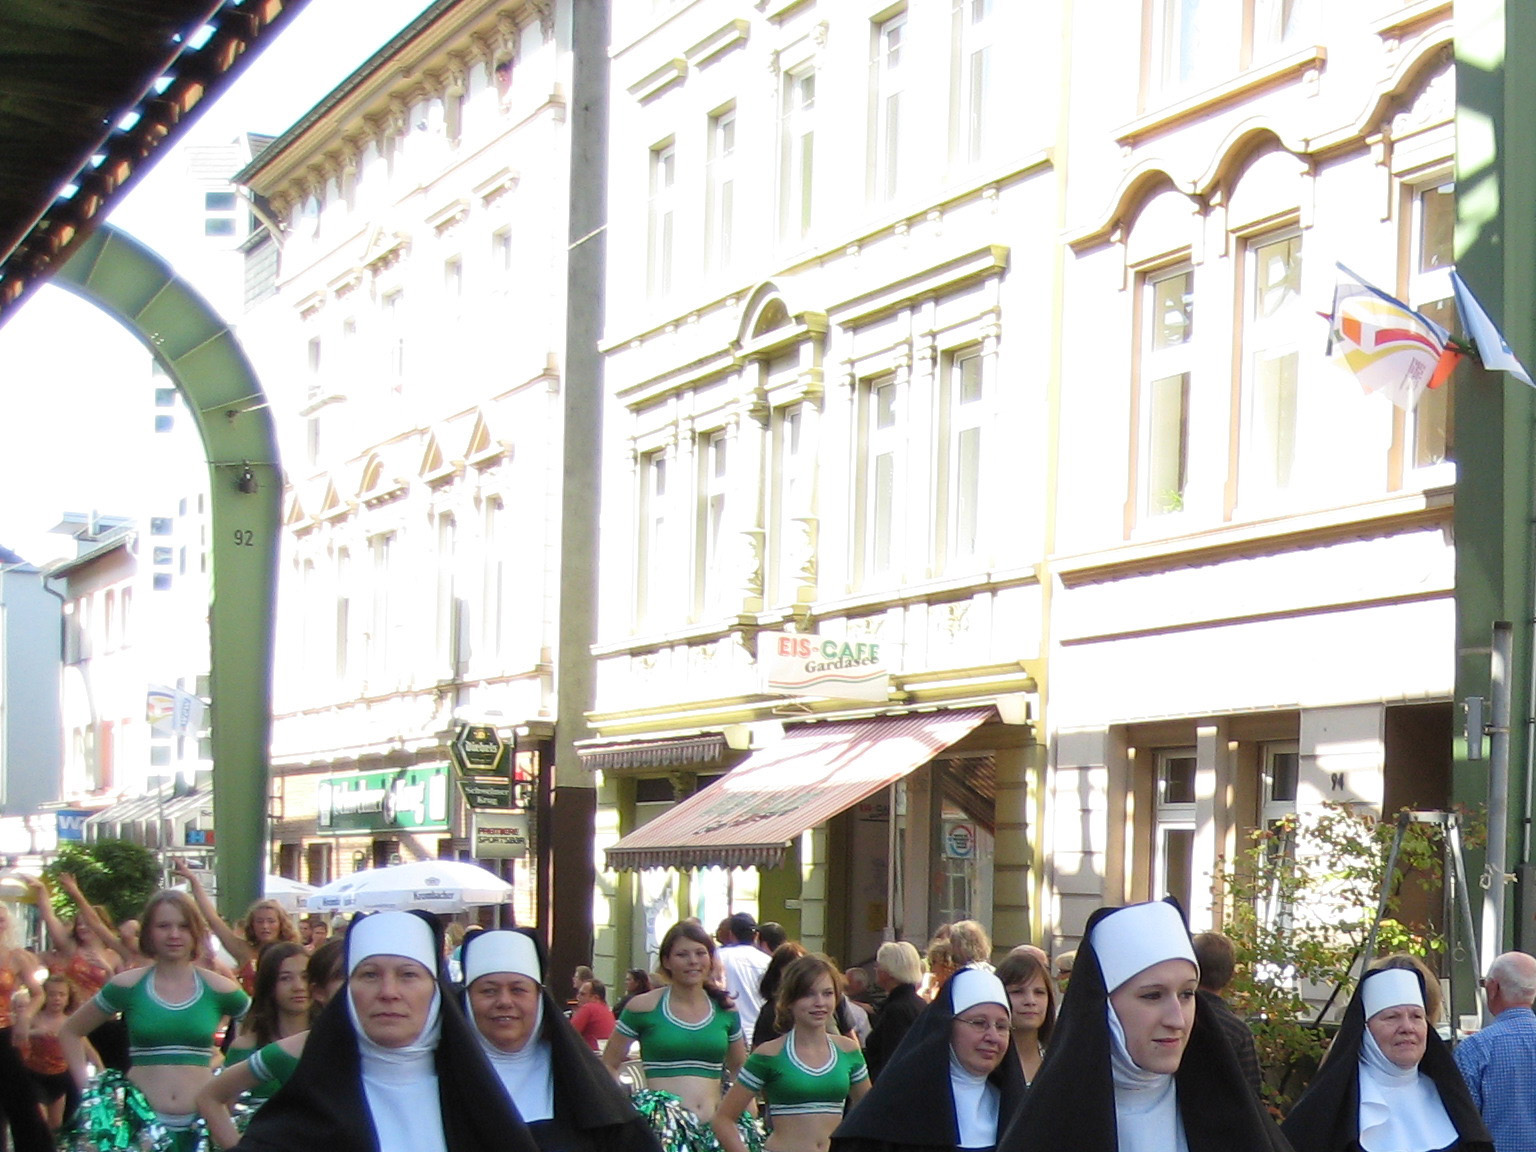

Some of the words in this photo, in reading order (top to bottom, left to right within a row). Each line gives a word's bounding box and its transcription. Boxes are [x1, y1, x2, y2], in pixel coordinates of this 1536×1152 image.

[233, 530, 254, 547] 92
[804, 655, 880, 674] Gardasee
[1331, 772, 1345, 791] 94
[413, 891, 454, 901] Krombacher
